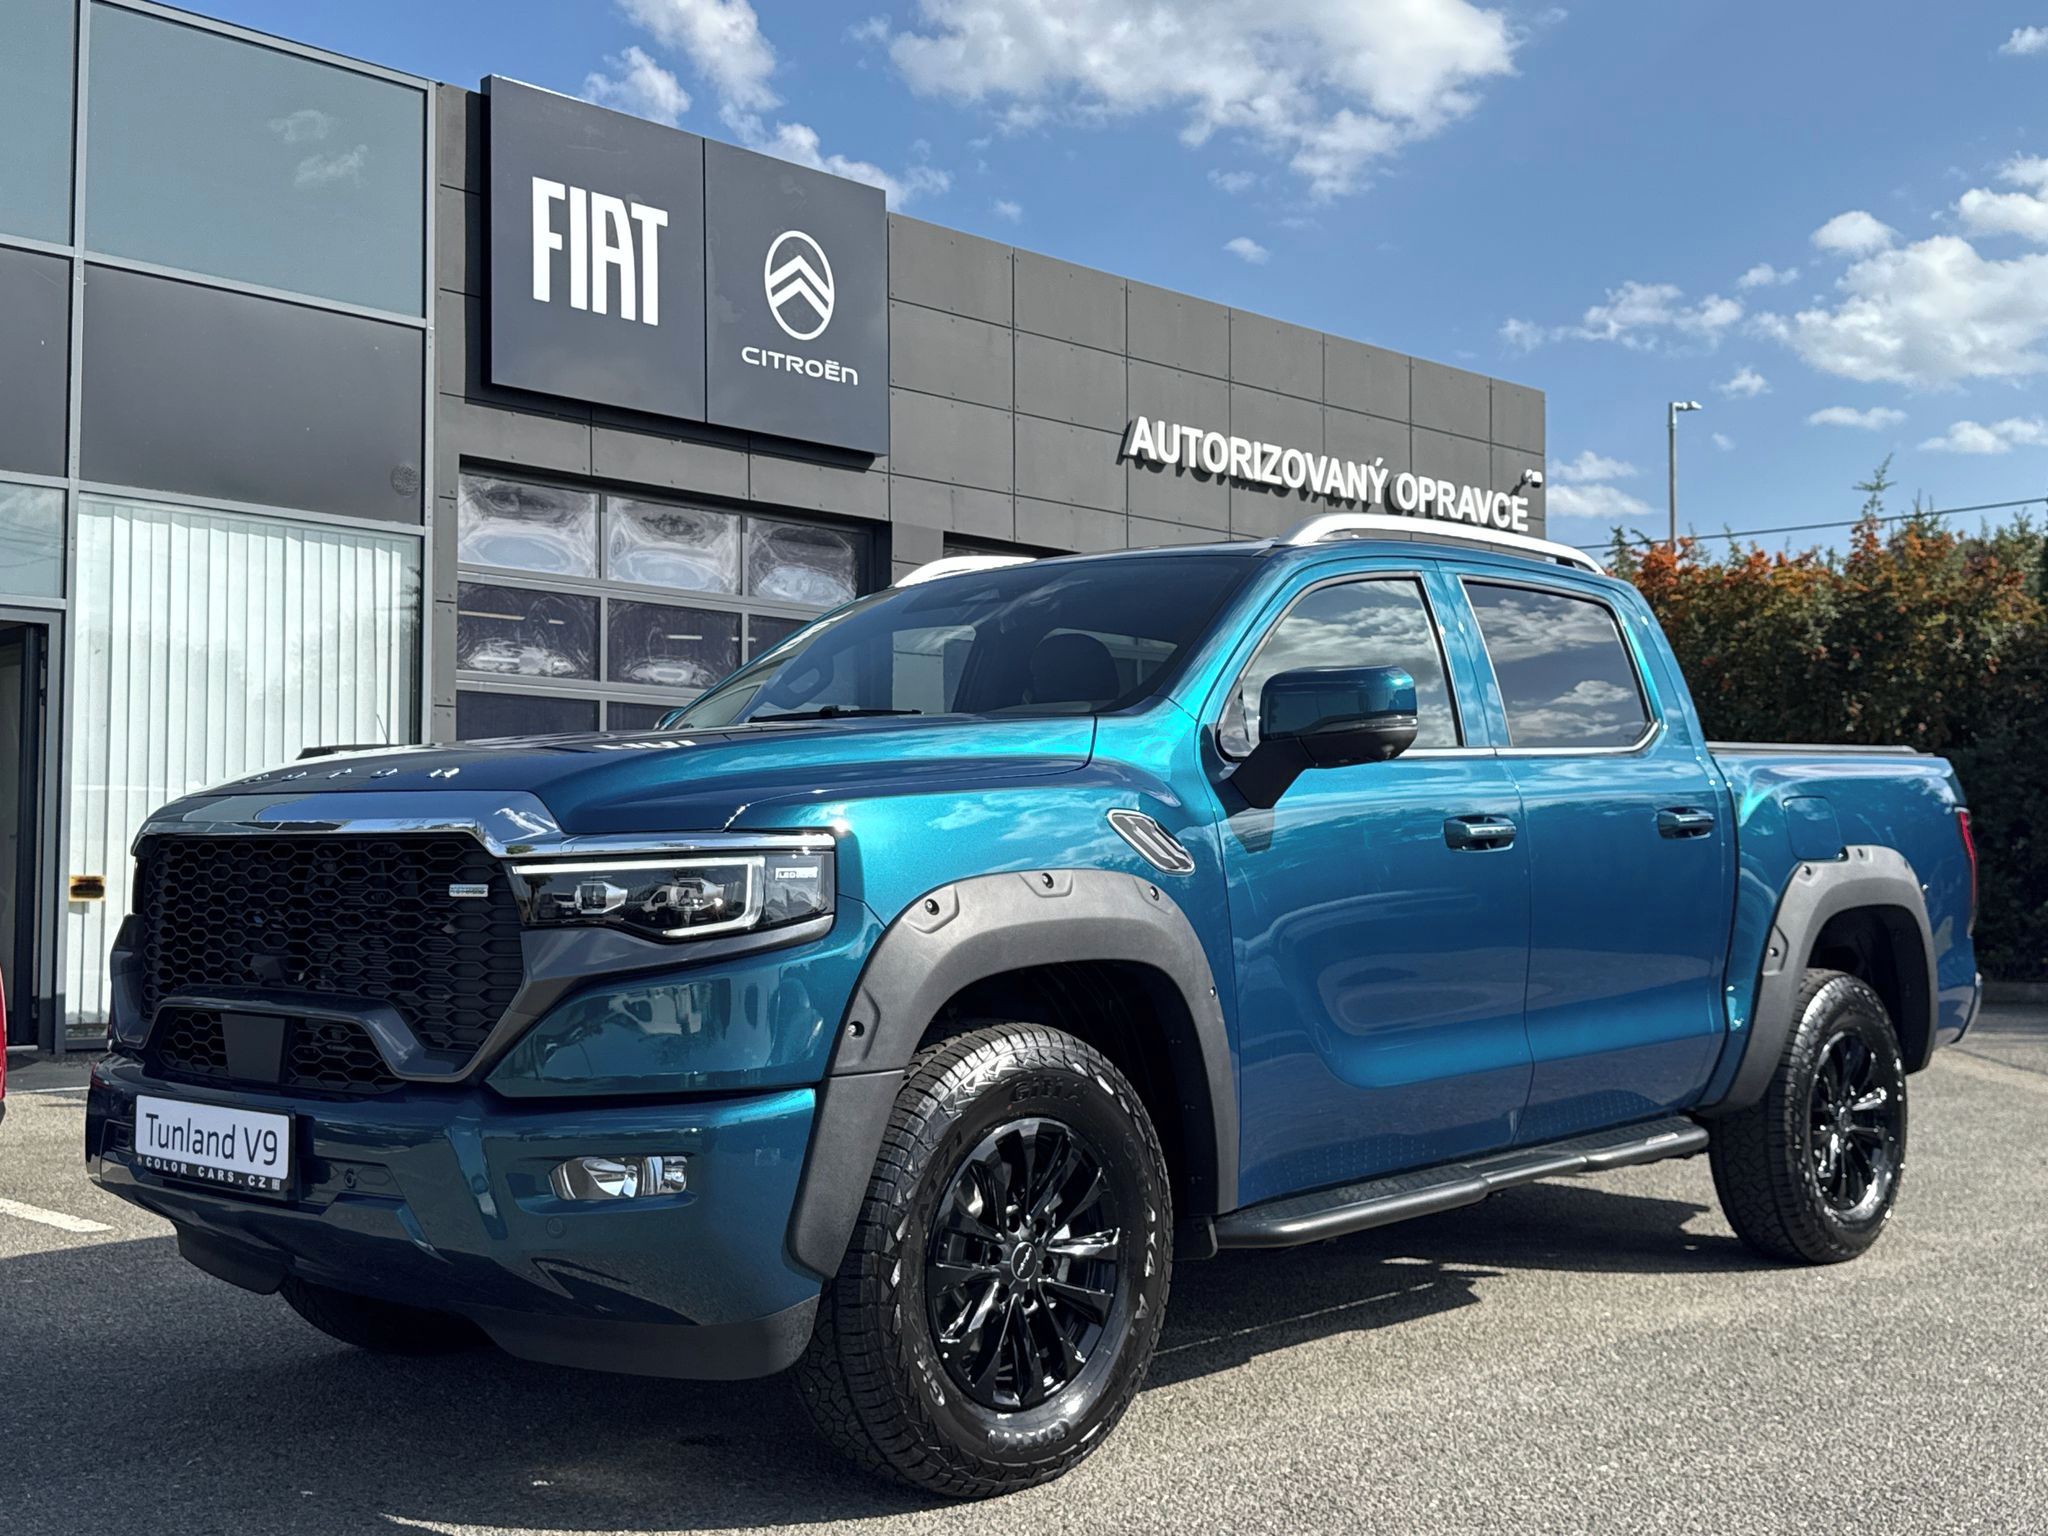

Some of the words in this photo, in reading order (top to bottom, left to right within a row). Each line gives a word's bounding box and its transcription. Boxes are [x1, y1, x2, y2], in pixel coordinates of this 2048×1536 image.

[532, 176, 669, 326] FIAT
[1129, 416, 1389, 504] AUTORIZOVANÝ
[1396, 472, 1529, 531] OPRAVCE
[146, 1113, 236, 1160] Tunland
[244, 1128, 278, 1166] V9
[146, 1156, 188, 1175] COLOR
